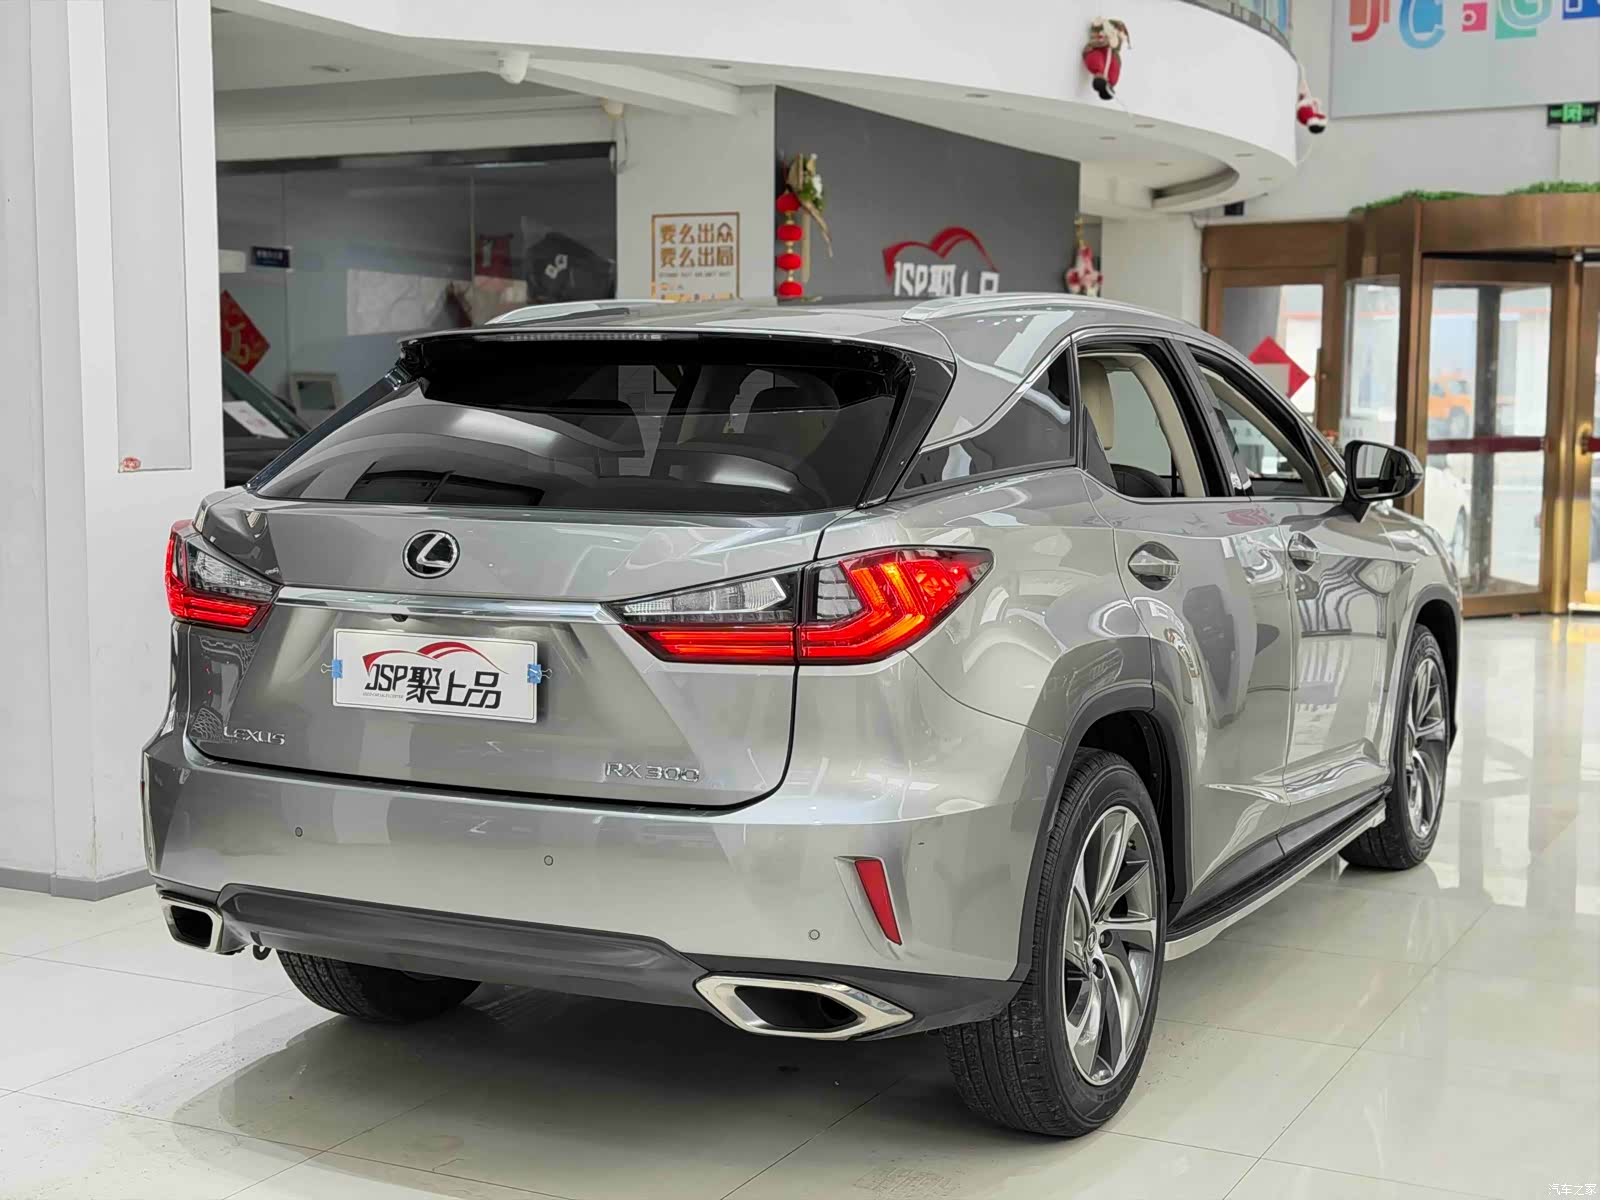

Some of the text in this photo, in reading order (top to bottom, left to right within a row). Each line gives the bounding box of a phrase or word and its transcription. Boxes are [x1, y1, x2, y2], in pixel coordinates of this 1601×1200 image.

[660, 222, 734, 244] 要么出众
[660, 246, 734, 268] 要么出局
[223, 726, 286, 745] LEXUS
[605, 762, 700, 782] RX 300
